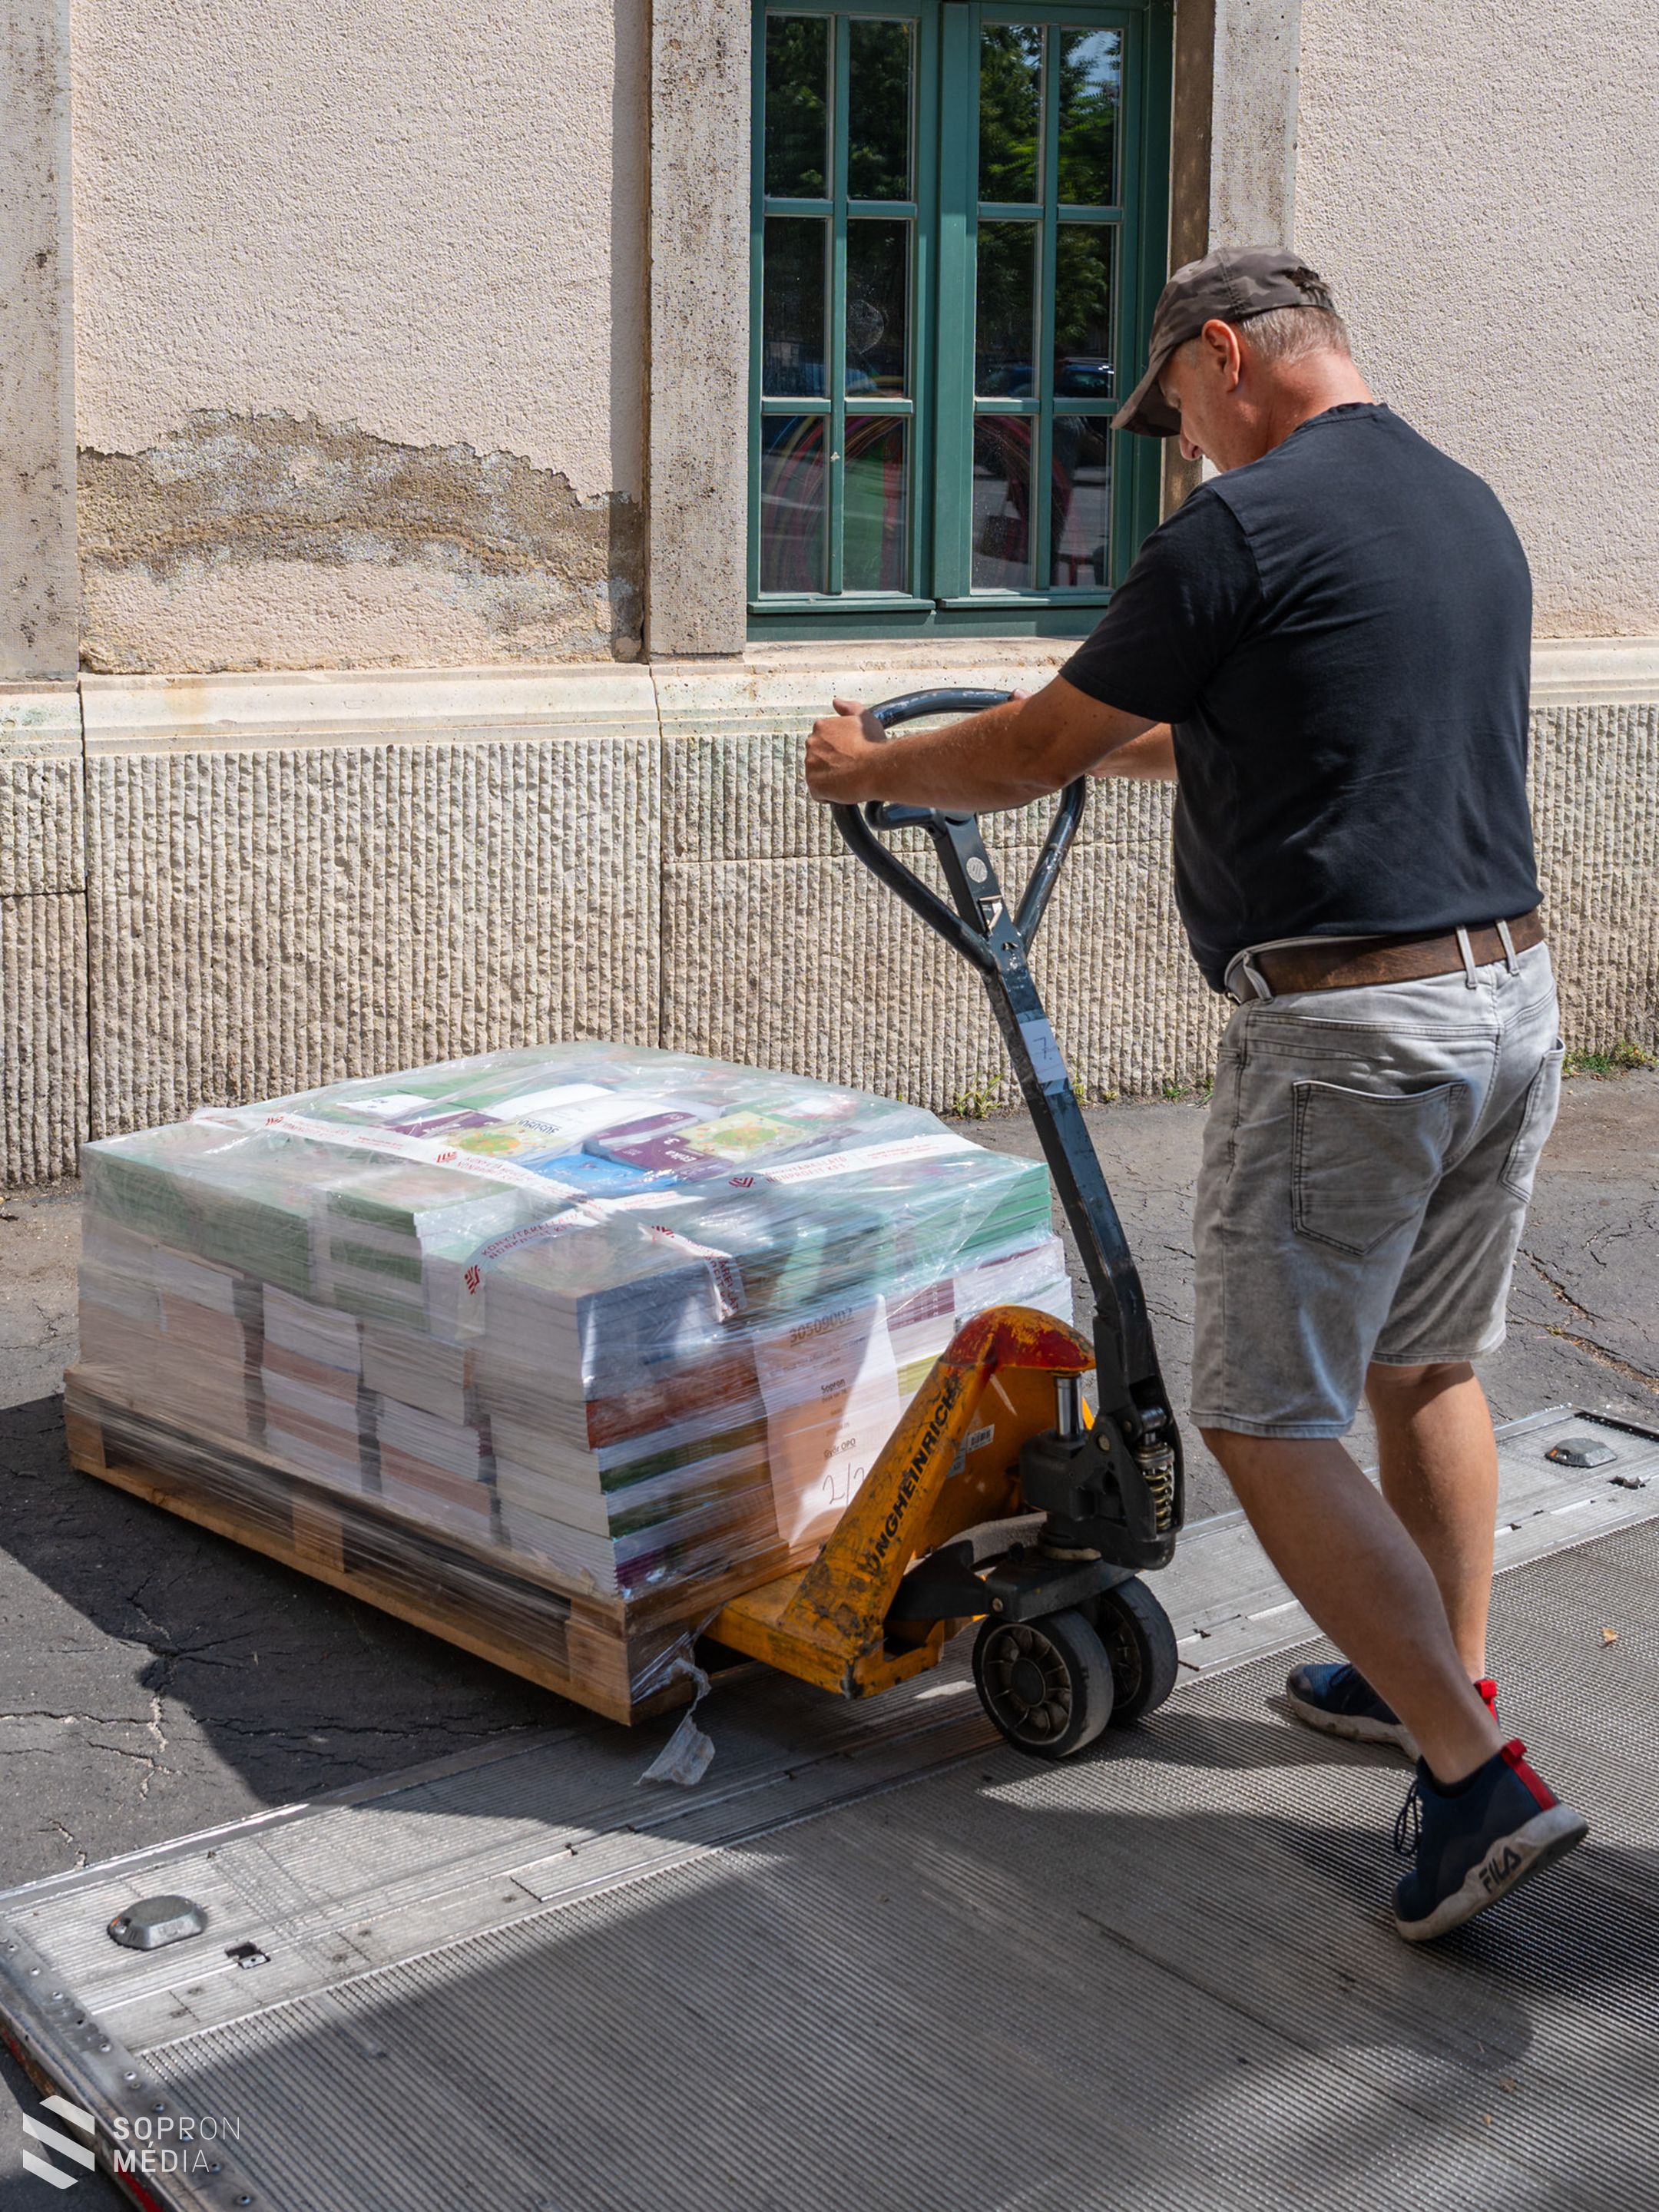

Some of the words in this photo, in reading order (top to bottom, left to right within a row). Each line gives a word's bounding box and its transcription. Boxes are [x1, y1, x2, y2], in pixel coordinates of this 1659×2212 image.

[820, 1378, 846, 1394] Sopron
[855, 1377, 960, 1575] UNGHEINRICH
[1479, 1846, 1522, 1894] FILA
